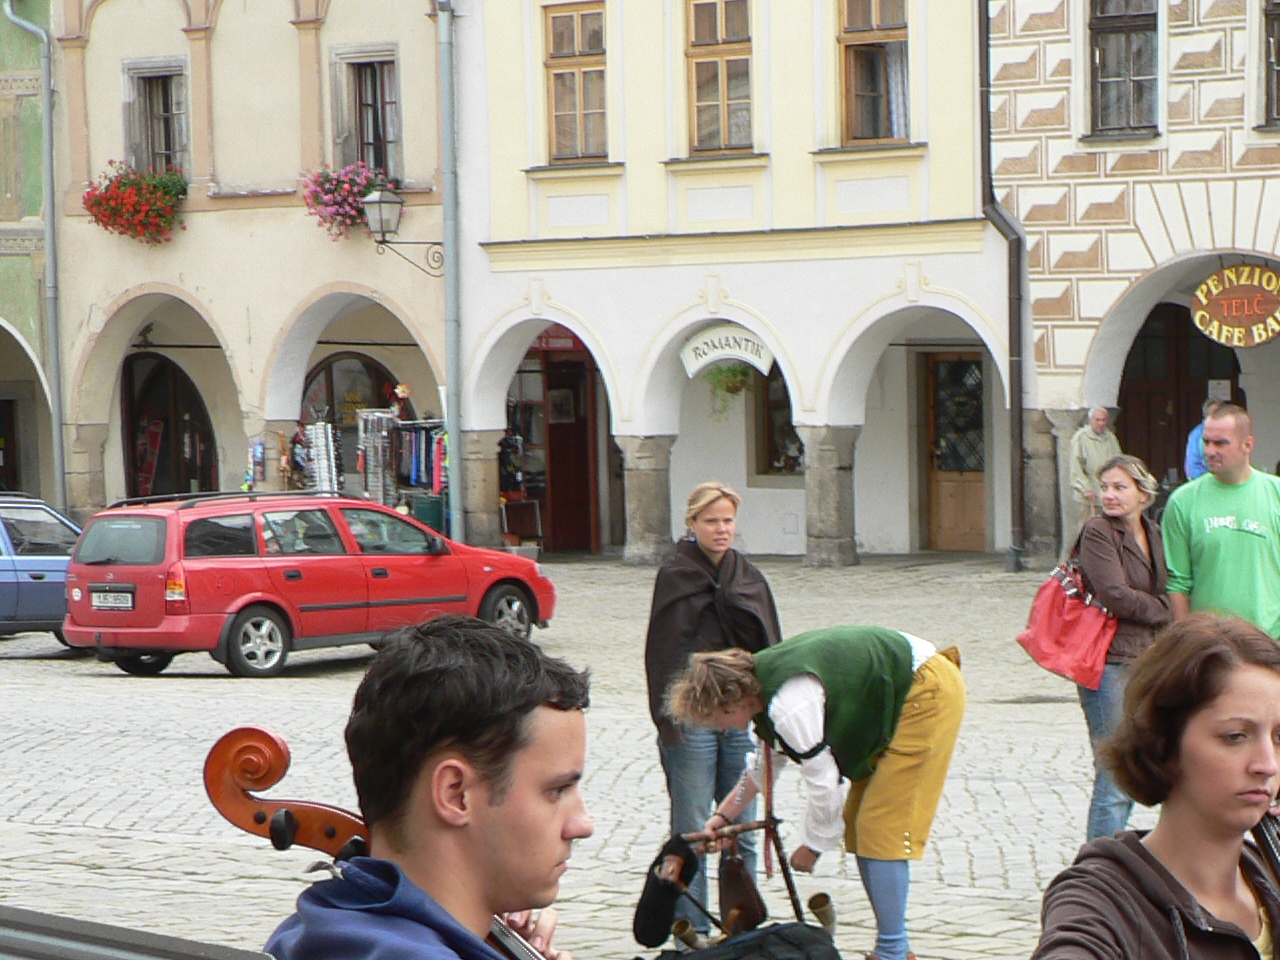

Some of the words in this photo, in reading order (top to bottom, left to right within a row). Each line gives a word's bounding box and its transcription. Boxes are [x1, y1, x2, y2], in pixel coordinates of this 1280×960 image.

[1219, 293, 1266, 317] TELČ
[1194, 309, 1246, 347] CAFE
[692, 335, 764, 360] ROMANTIK
